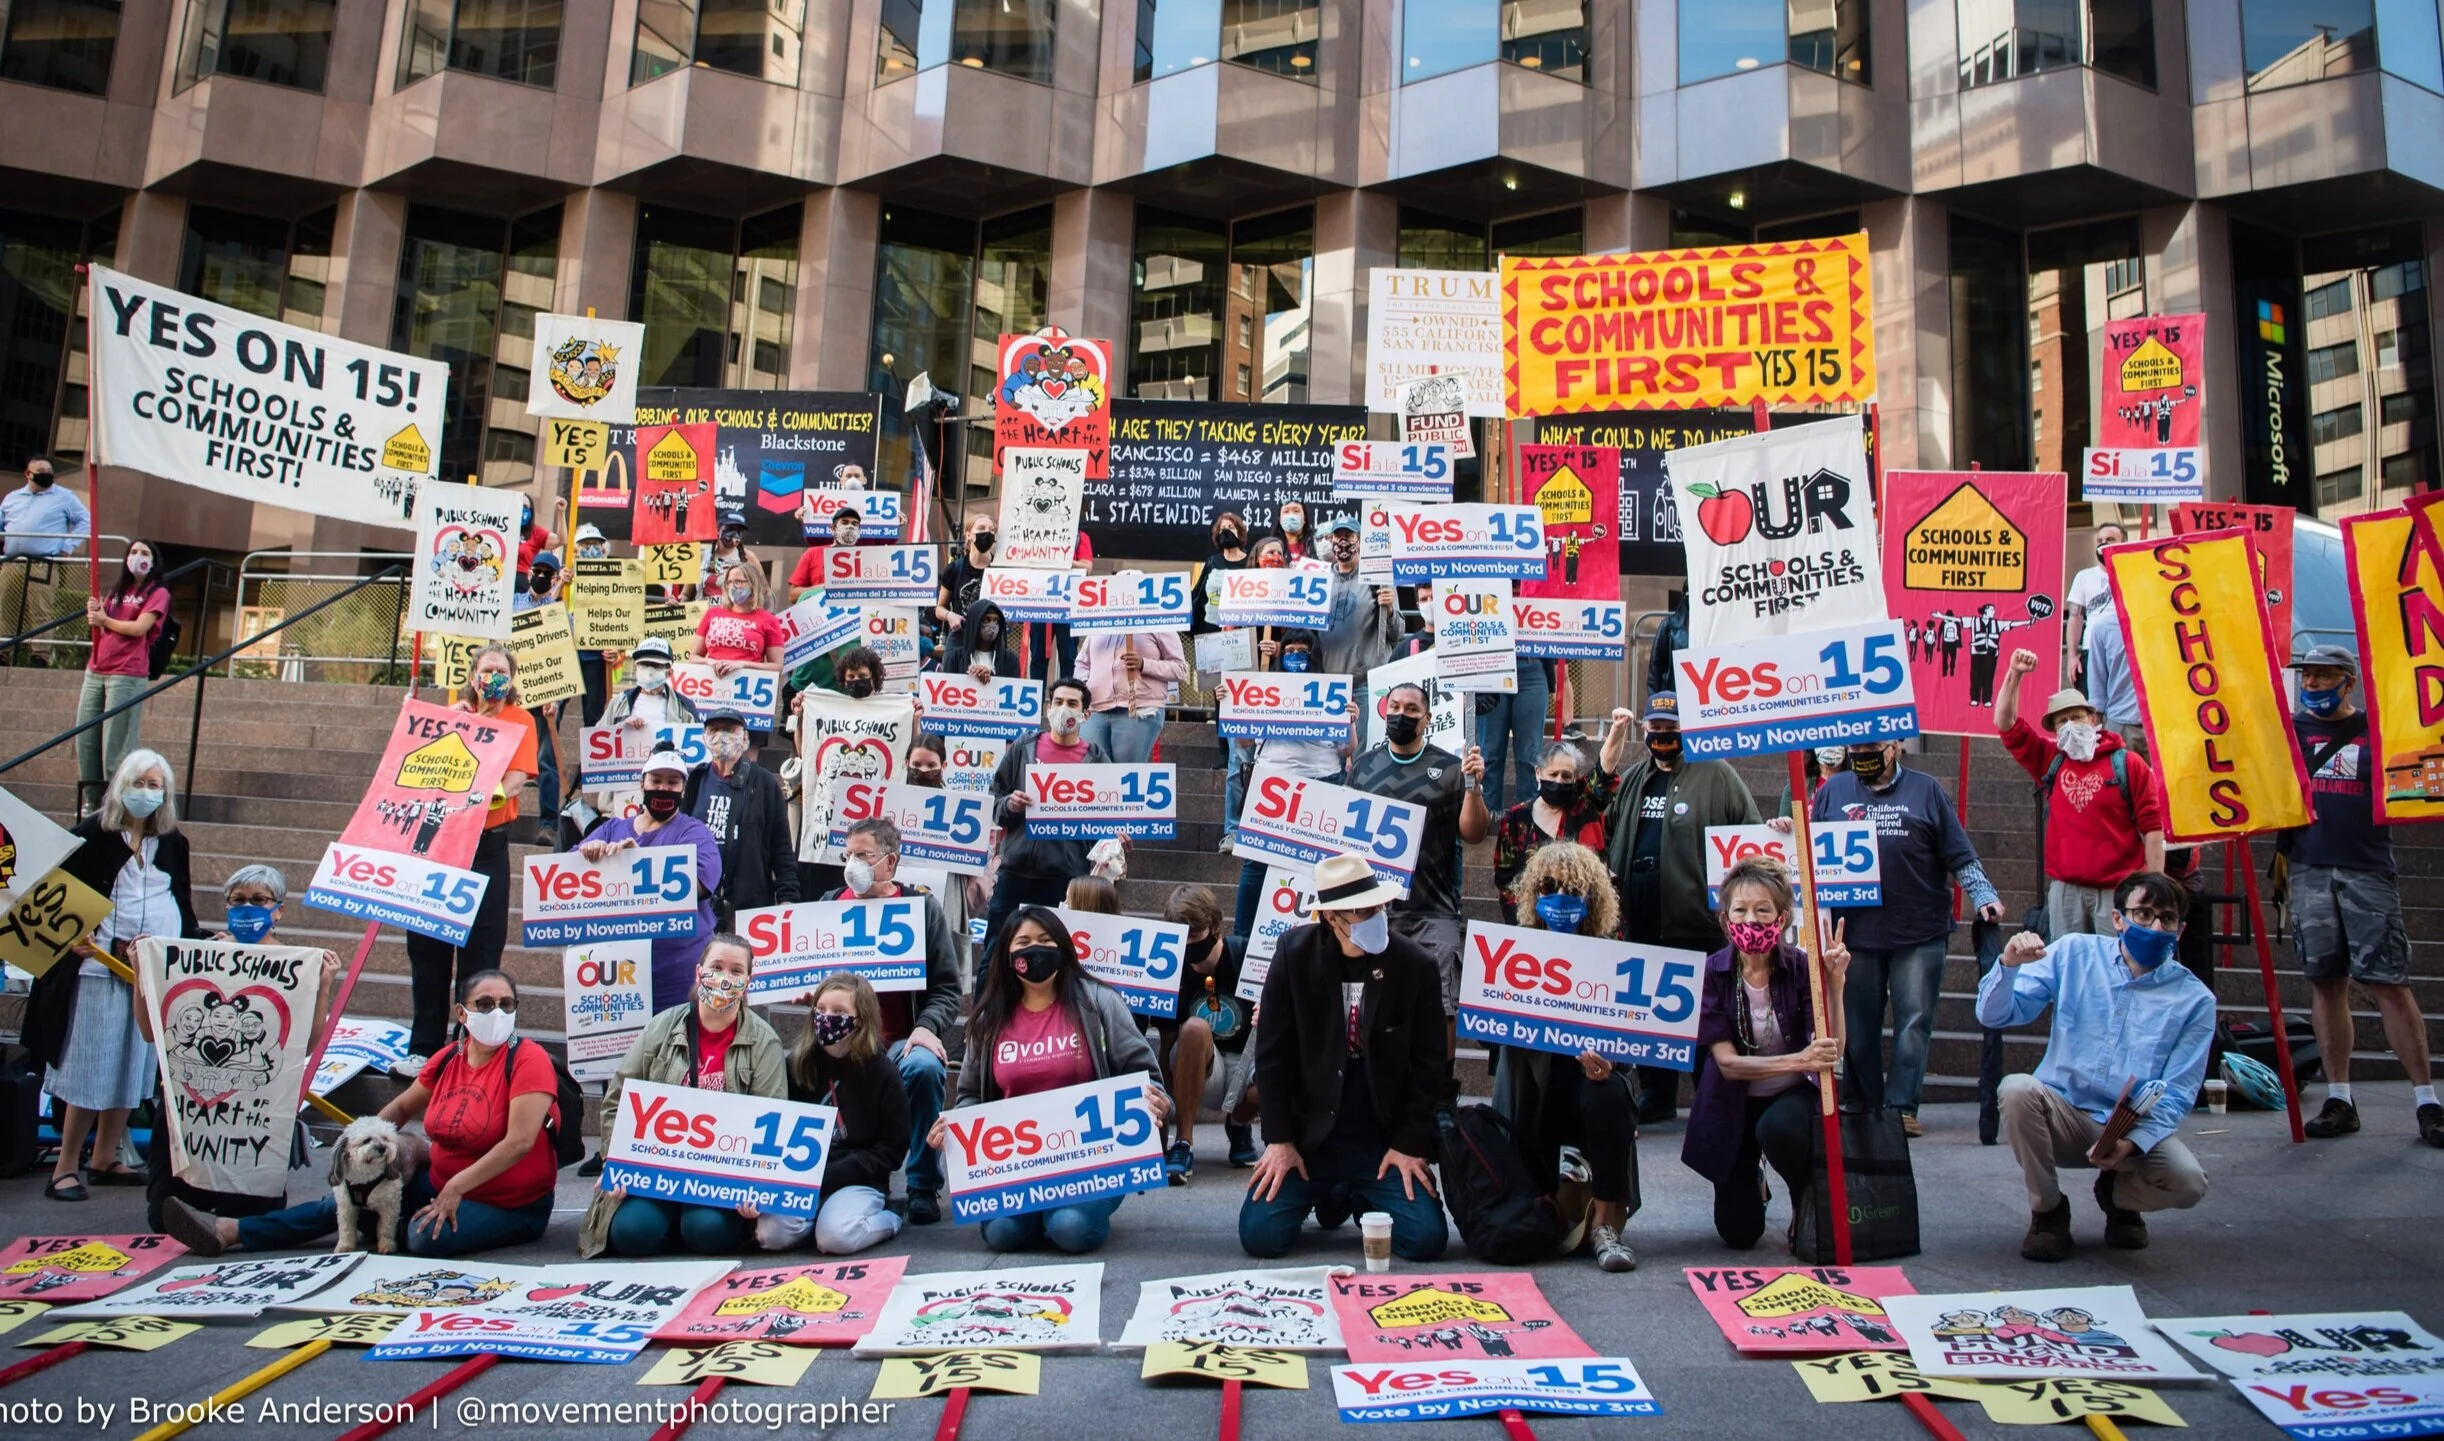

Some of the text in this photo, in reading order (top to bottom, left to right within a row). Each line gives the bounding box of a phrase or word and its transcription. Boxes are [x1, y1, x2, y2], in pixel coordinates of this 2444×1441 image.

[1386, 275, 1494, 299] TRUM
[1539, 258, 1824, 312] SCHOOLS &
[1423, 316, 1479, 328] OWNED
[1530, 299, 1834, 355] COMMUNITIES
[1383, 327, 1500, 341] 555 CALIFORN
[2110, 326, 2181, 349] YES 15
[105, 286, 421, 413] YES ON 15!
[1383, 339, 1415, 349] SAN
[2128, 358, 2164, 368] SCHOOLS
[1555, 348, 1842, 399] FIRST YES 15
[2123, 368, 2180, 379] COMMUNITIES
[2141, 378, 2162, 388] FIRST
[165, 367, 356, 441] SCHOOLS &
[635, 407, 873, 431] OBBING OUR SCHOOLS & COMMUNITIES?
[1410, 414, 1460, 430] FUND
[2265, 350, 2290, 486] Microsoft
[133, 391, 377, 472] COMMUNITIES
[553, 422, 598, 448] YES
[1121, 419, 1366, 447] ARE THEY TAKING EVERY YEAR?
[1408, 430, 1464, 442] PUBLIC
[1541, 426, 1704, 450] WHAT COULD WE DO
[391, 440, 418, 453] SCHOOLS
[760, 434, 846, 452] Blackstone
[206, 439, 303, 488] FIRST!
[385, 447, 428, 464] COMMUNITIES
[396, 460, 414, 469] FIRST
[562, 448, 587, 464] 15
[653, 450, 685, 460] SCHOOLS
[1218, 447, 1263, 467] $468
[648, 460, 696, 471] COMMUNITIES
[662, 469, 684, 479] FIRST
[762, 459, 805, 471] Chevron
[1129, 467, 1202, 481] $3.74 BILLION
[1214, 471, 1272, 484] SAN DIEGO
[1083, 483, 1201, 499] CLARA $678 MILLION
[1213, 489, 1259, 501] ALAMEDA
[1110, 502, 1272, 529] STATEWIDE $12
[1394, 512, 1540, 550] Yes on 15
[1921, 529, 2011, 545] SCHOOLS &
[1006, 545, 1071, 560] COMMUNITY
[1908, 549, 2021, 567] COMMUNITIES
[832, 550, 931, 584] Sí a la 15
[1396, 563, 1544, 579] Vote by November 3rd
[1720, 549, 1855, 584] SCHOOLS &
[1702, 565, 1865, 606] COMMUNITIES
[1942, 570, 1986, 587] FIRST
[576, 583, 642, 596] Helping Drivers
[828, 591, 843, 599] vote
[865, 590, 878, 598] del
[898, 589, 934, 598] noviembre
[425, 602, 500, 626] COMMUNITY
[588, 608, 631, 619] Helps Our
[1444, 593, 1499, 616] OUR
[1754, 591, 1820, 619] FIRST
[2031, 600, 2051, 613] VOTE
[589, 623, 629, 632] Students
[1441, 627, 1508, 637] COMMUNITIES
[1449, 621, 1495, 630] SCHOOLS
[589, 637, 639, 650] Community
[1463, 635, 1490, 644] FIRST
[1680, 633, 1904, 706] Yes on 15
[2153, 543, 2250, 827] SCHOOLS
[408, 715, 499, 743] YES 15
[415, 754, 460, 766] SCHOOLS
[404, 764, 473, 779] COMMUNITIES
[420, 777, 449, 787] FIRST
[1254, 776, 1411, 859] Sí a la 15
[1865, 811, 1900, 820] Alliance
[1867, 805, 1909, 813] California
[332, 850, 480, 915] Yes on 15
[0, 882, 67, 947] Yes
[34, 907, 84, 957] 15
[165, 945, 303, 990] PUBLIC SCHOOLS
[1473, 934, 1695, 1023] Yes on 15
[628, 1091, 825, 1172] Yes on 15
[948, 1085, 1152, 1167] Yes on 15
[727, 1264, 868, 1291] YES 15
[1692, 1268, 1852, 1292] YES 15
[1342, 1365, 1637, 1394] Yes on 15
[2007, 1379, 2143, 1401] YES
[2248, 1384, 2419, 1411] Yes
[2050, 1396, 2125, 1417] 15
